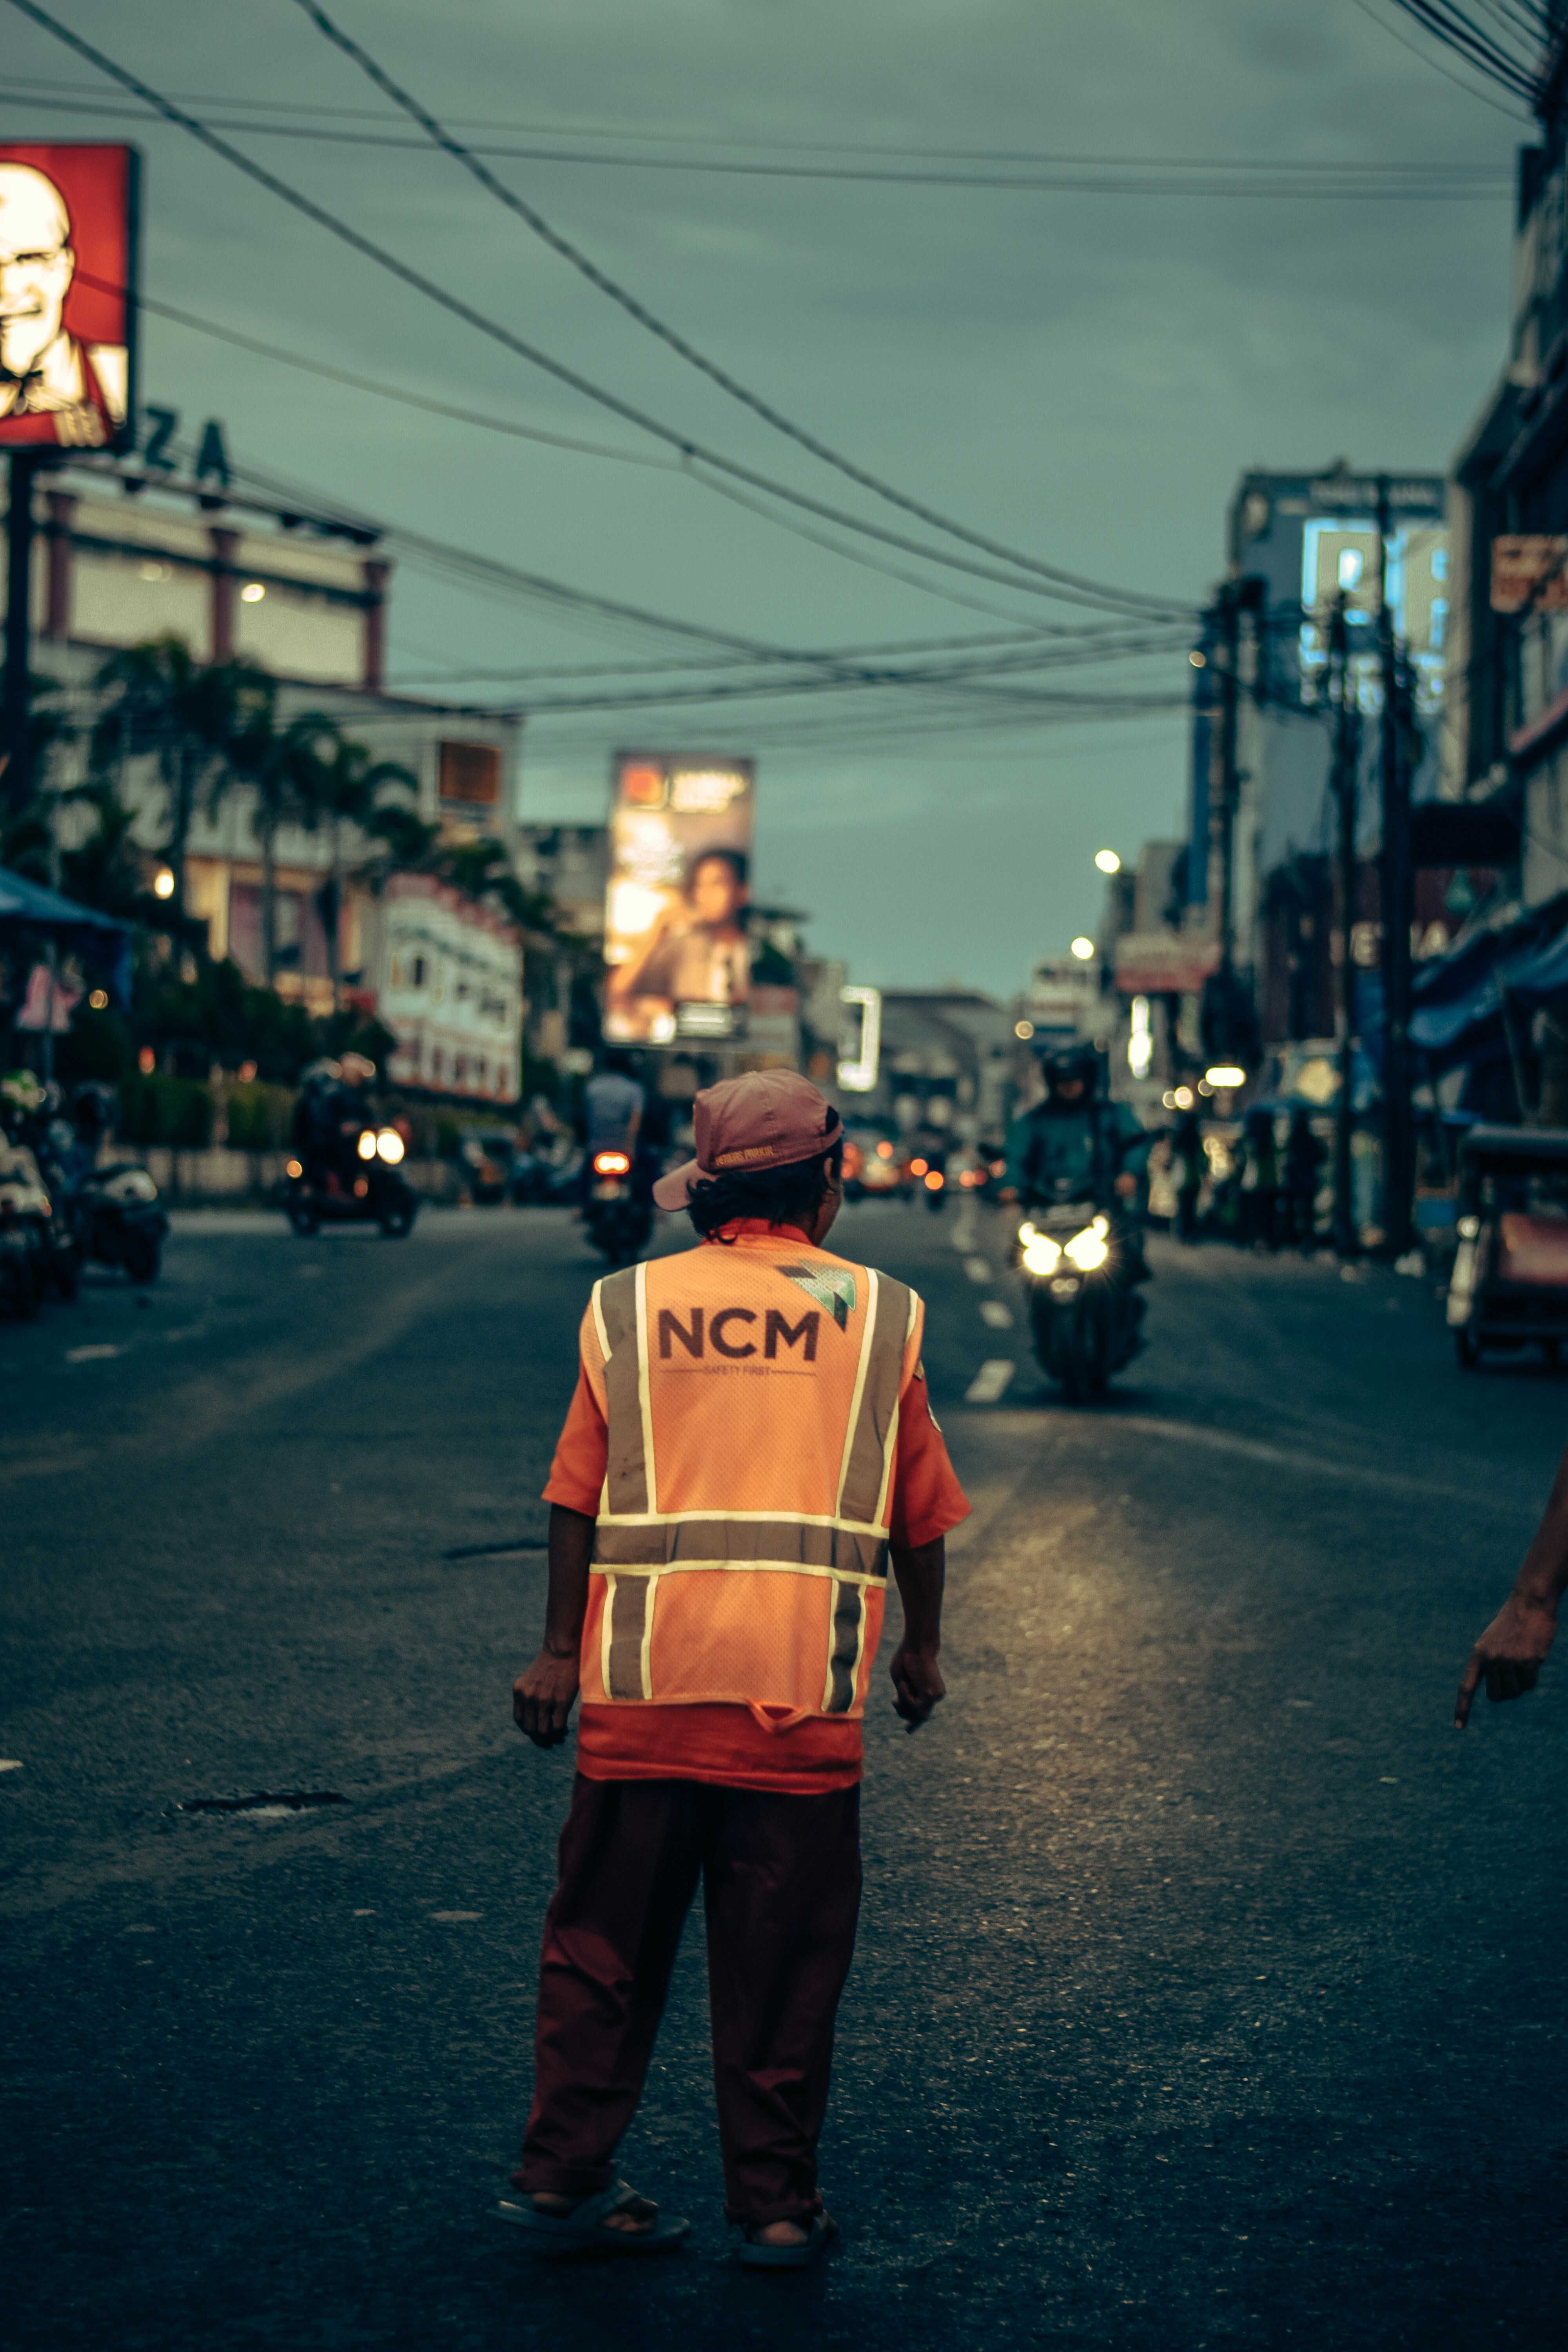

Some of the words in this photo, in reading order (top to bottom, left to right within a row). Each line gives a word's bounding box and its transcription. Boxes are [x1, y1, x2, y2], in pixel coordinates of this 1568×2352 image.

[744, 1145, 774, 1160] PARKIR
[658, 1307, 820, 1361] NCM
[704, 1365, 740, 1376] SAFETY
[743, 1365, 770, 1376] FIRST
